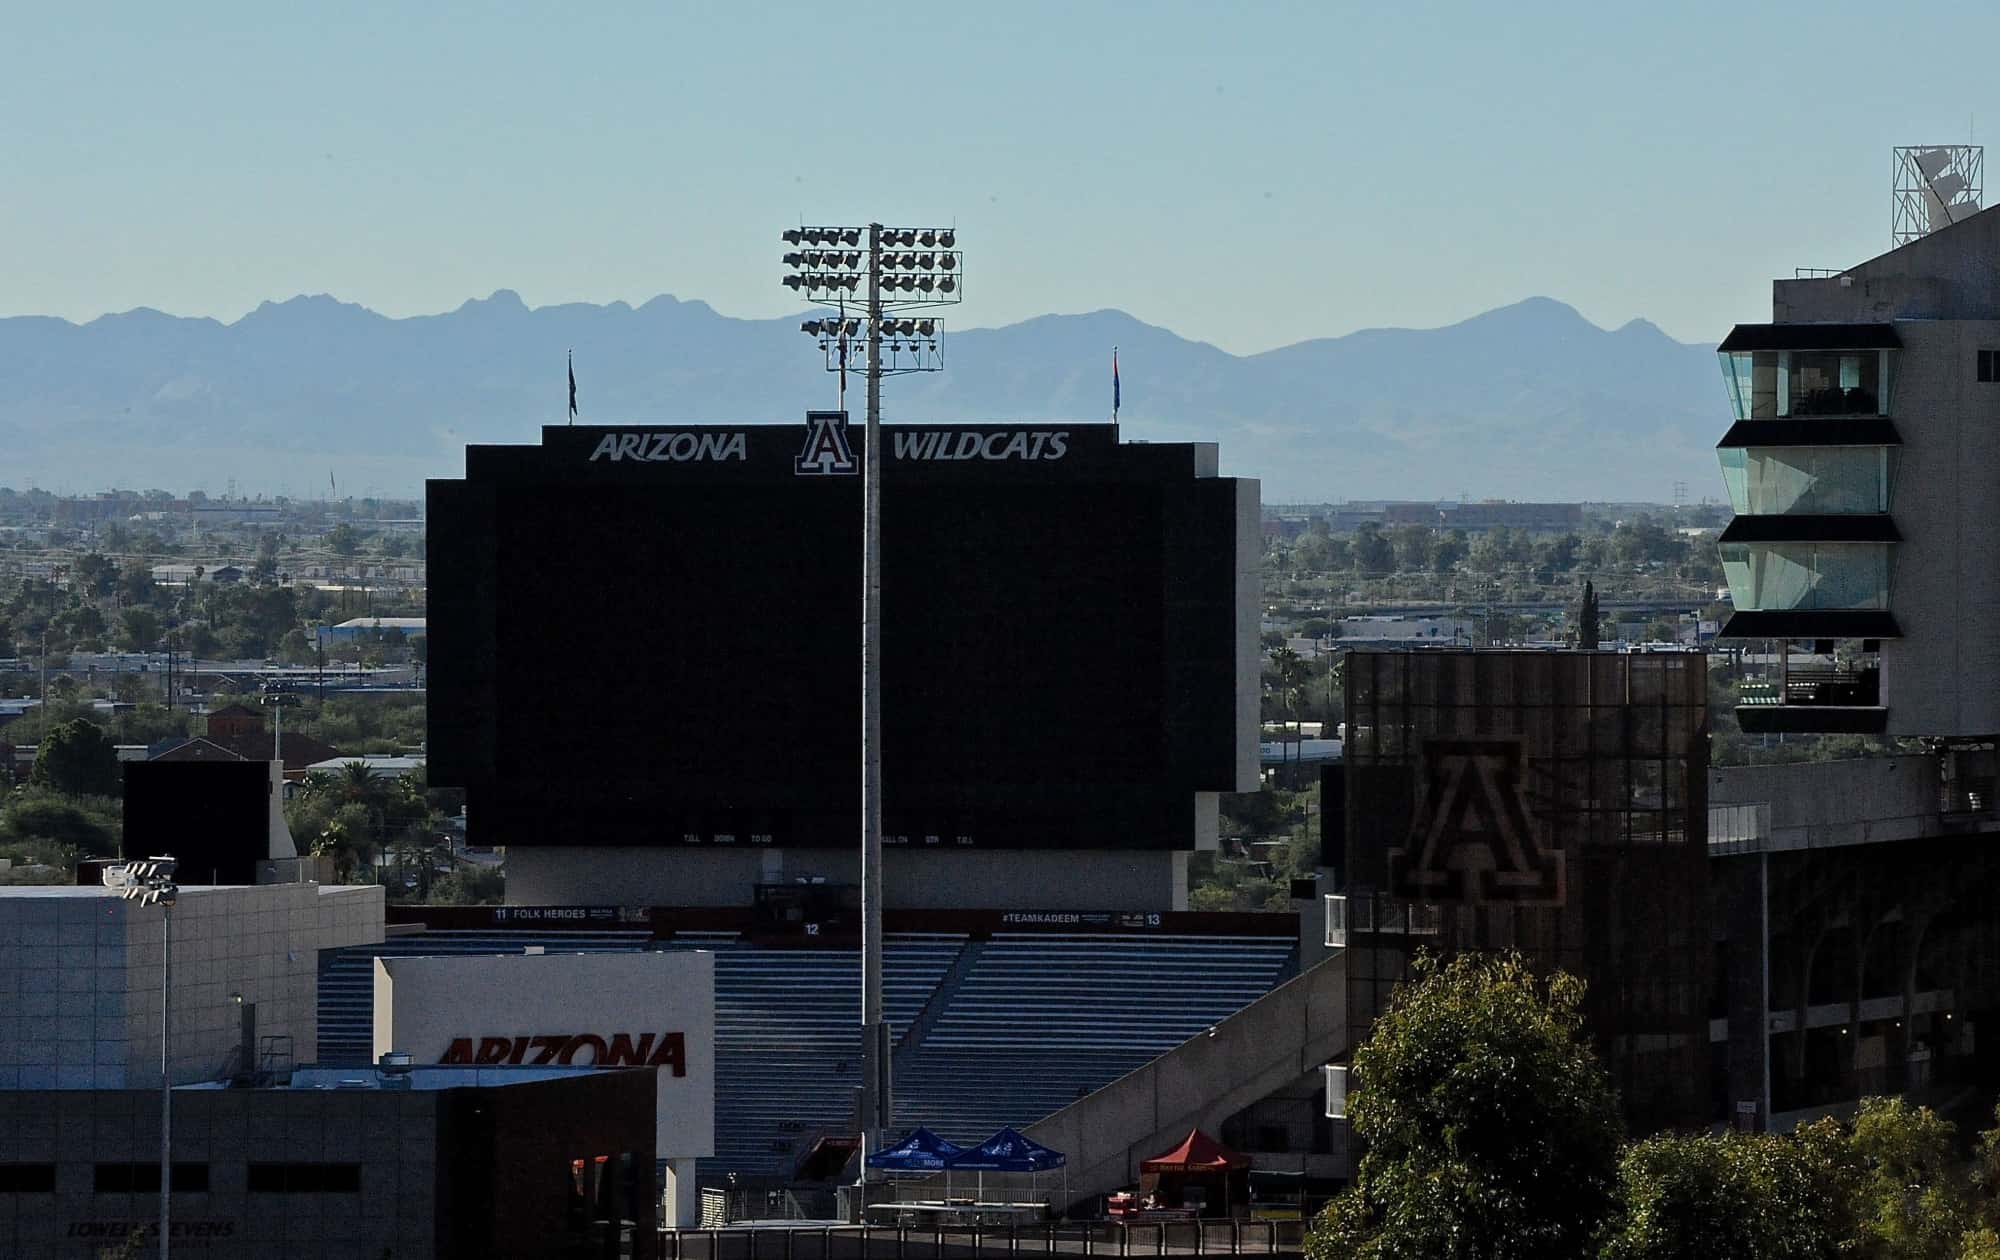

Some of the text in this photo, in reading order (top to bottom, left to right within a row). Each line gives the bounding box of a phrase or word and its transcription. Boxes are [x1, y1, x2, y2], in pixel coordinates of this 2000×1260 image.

[588, 411, 1071, 476] ARIZONA A WILDCATS
[1387, 738, 1567, 908] A
[514, 909, 541, 919] FOLK
[544, 909, 586, 919] HEROES
[1002, 914, 1080, 924] #TEAMKADEEM
[1147, 913, 1160, 926] 13
[804, 924, 819, 935] 12
